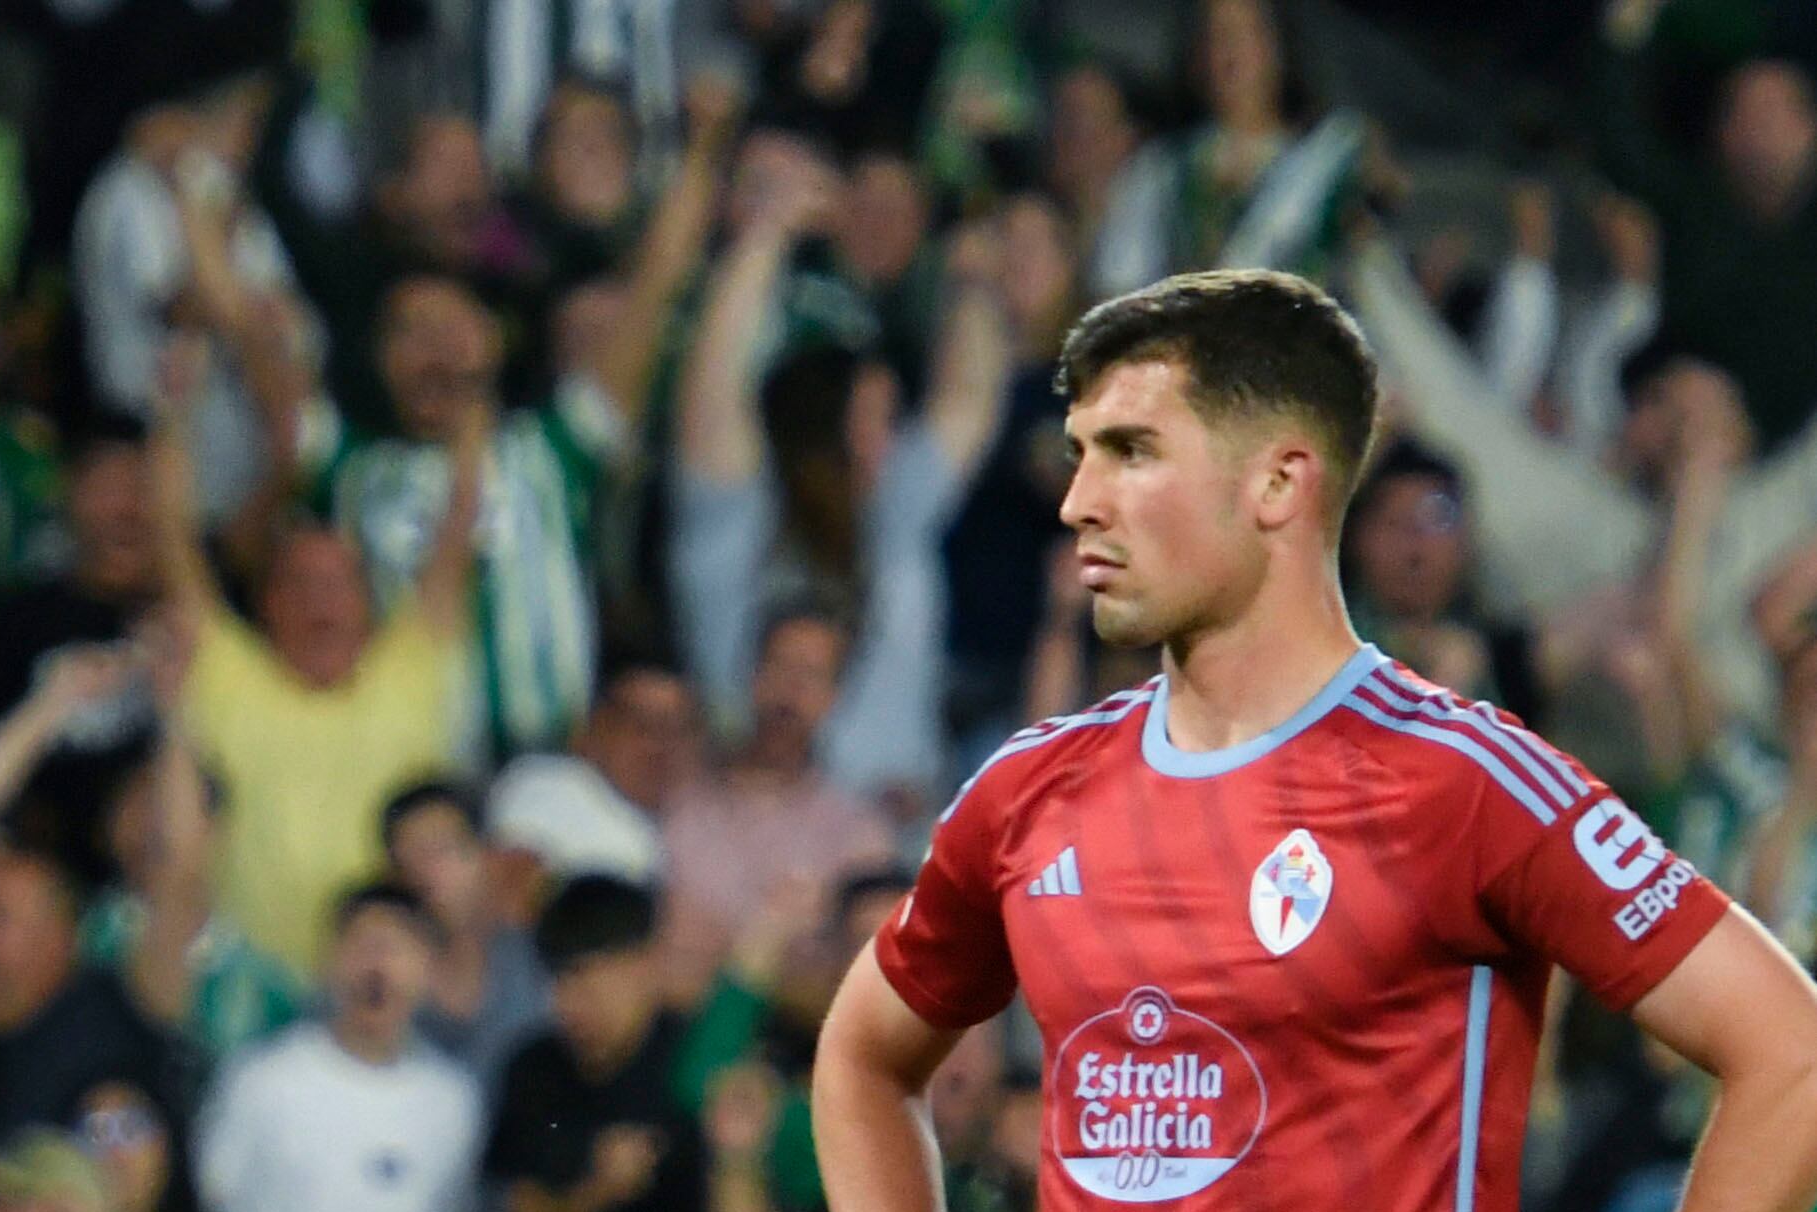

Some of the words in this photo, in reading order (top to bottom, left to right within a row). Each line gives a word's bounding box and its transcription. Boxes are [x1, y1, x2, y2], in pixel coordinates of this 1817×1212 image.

[1613, 858, 1695, 941] EBpo
[1074, 1052, 1223, 1099] Estrella
[1079, 1100, 1212, 1150] Galicia
